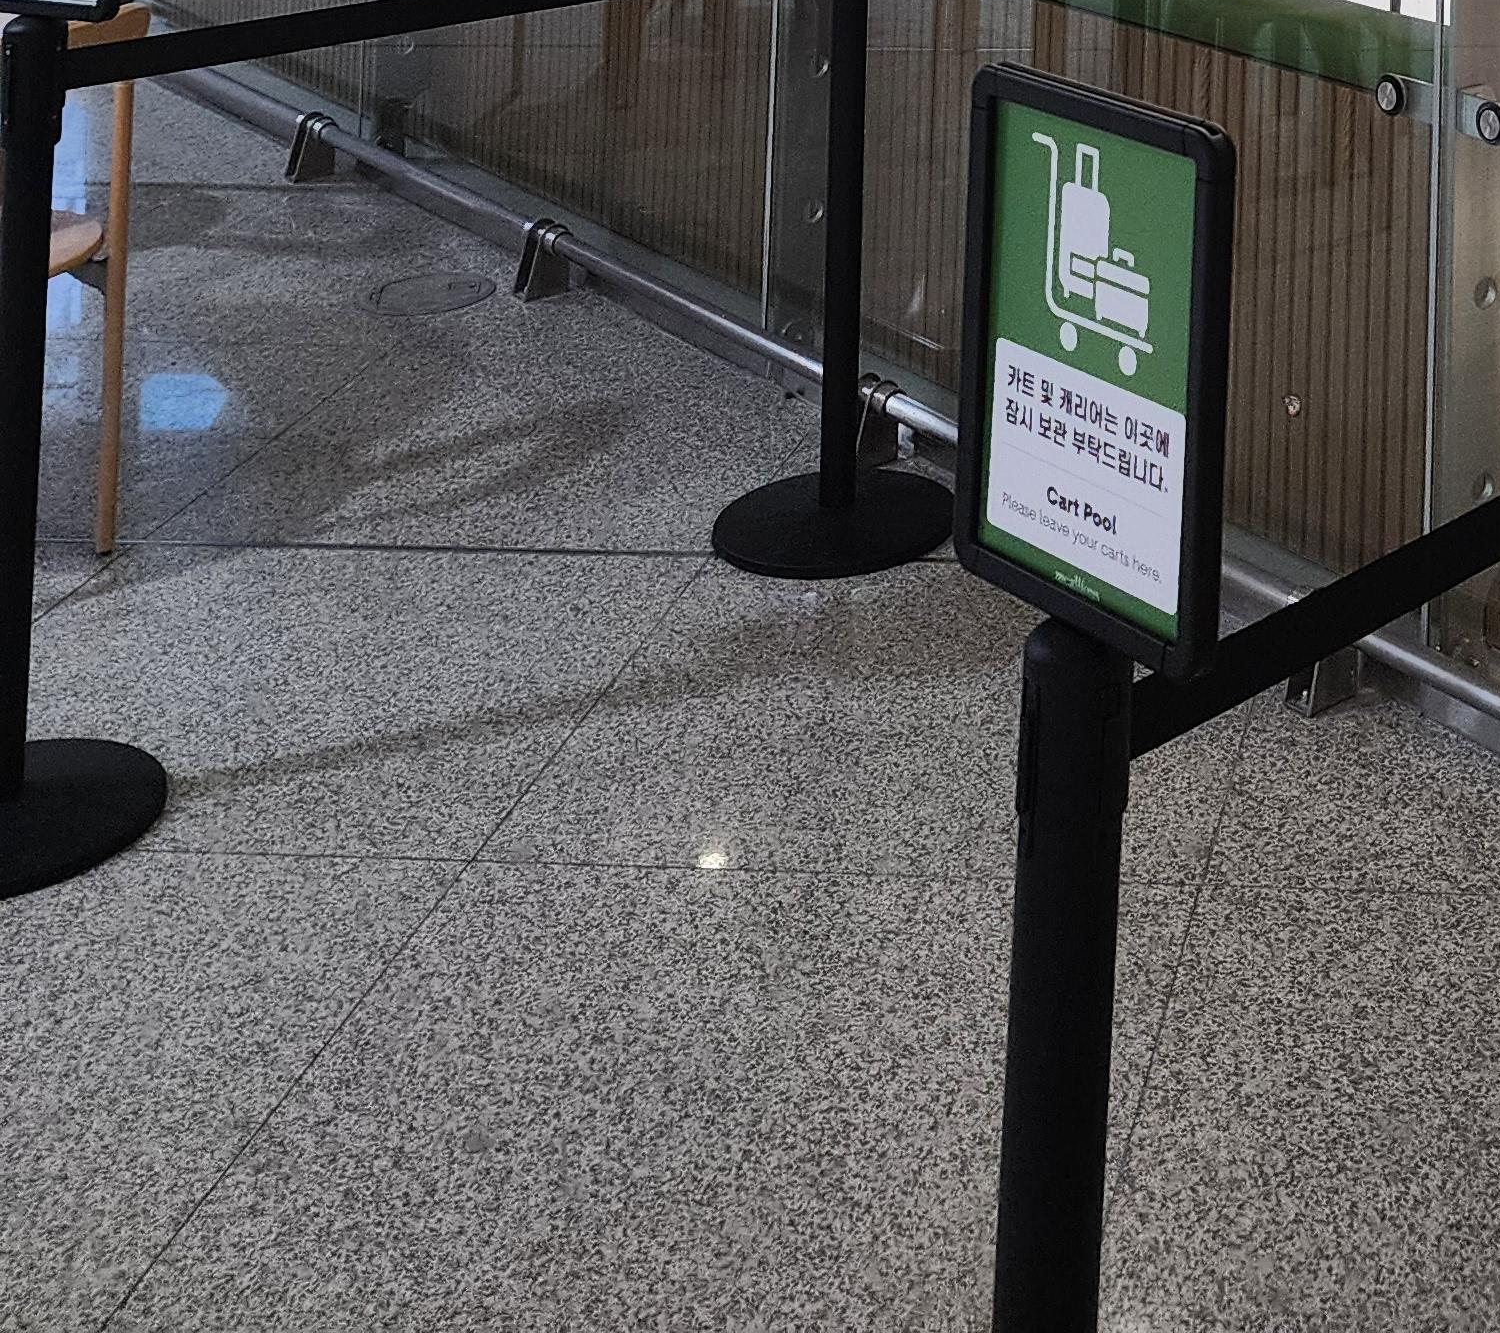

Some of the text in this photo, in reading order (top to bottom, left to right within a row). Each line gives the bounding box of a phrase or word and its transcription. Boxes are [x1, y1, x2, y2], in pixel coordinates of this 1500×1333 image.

[1005, 397, 1168, 493] 잠시 보관 부탁드립니다.
[1007, 364, 1170, 458] 카트 및 캐리어는 이곳에
[1002, 492, 1163, 584] Please leave your carts here.
[1046, 486, 1117, 535] Cart Pool
